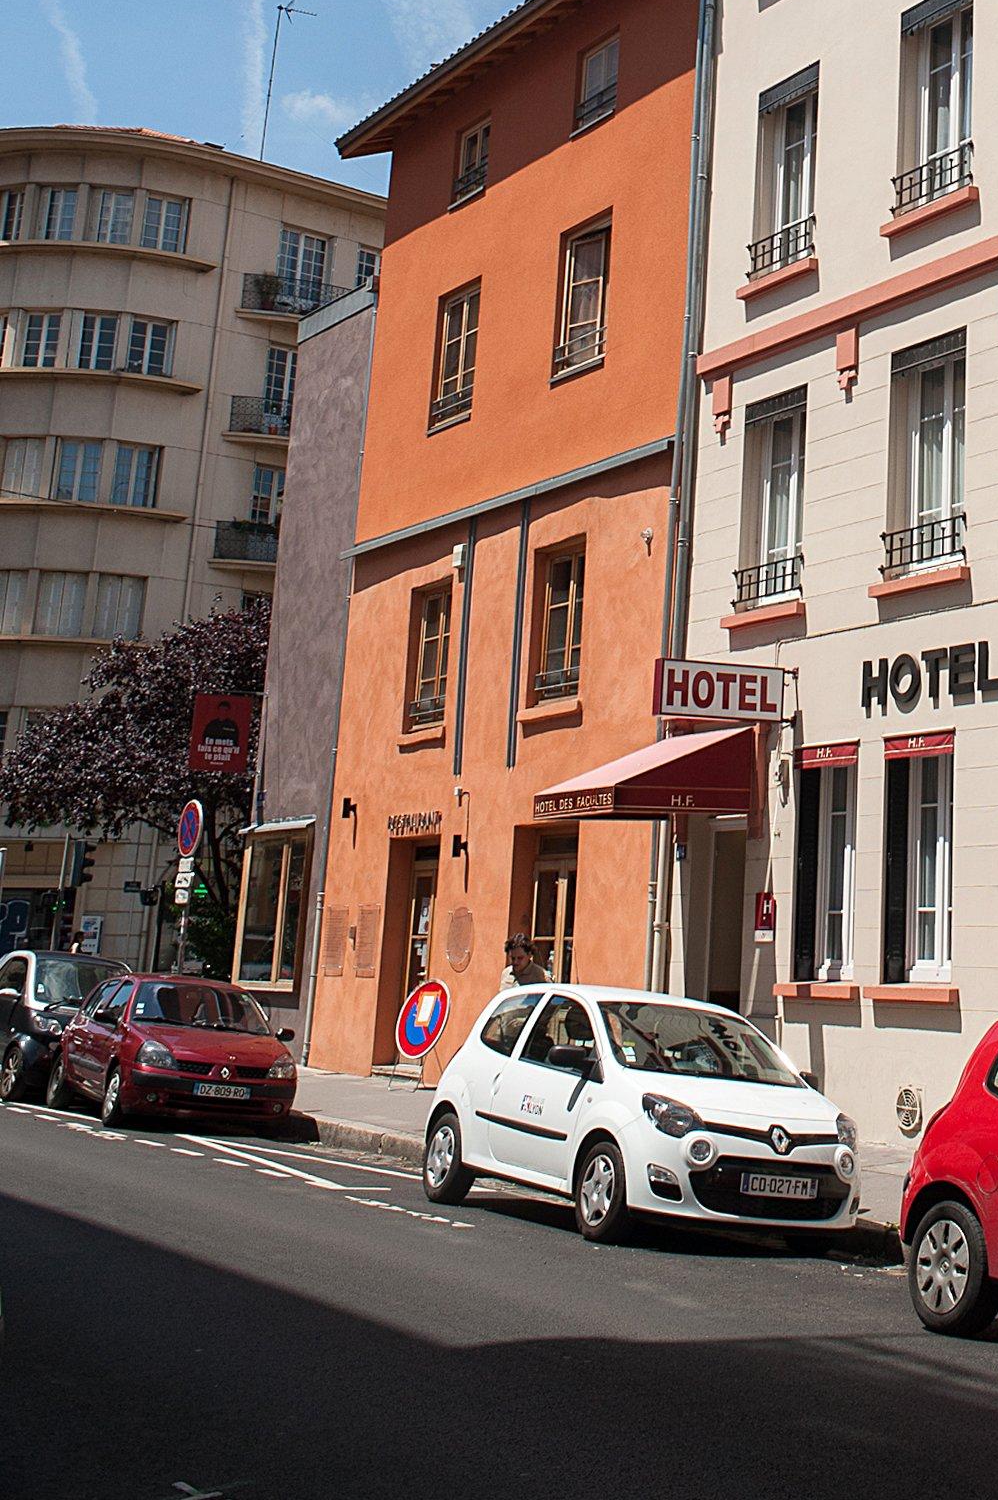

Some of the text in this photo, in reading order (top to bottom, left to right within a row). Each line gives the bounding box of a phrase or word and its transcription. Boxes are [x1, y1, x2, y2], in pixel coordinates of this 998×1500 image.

[666, 668, 777, 713] HOTEL
[535, 792, 612, 813] HOTEL DES FACULTES
[671, 795, 695, 807] H.F.
[763, 900, 772, 915] H
